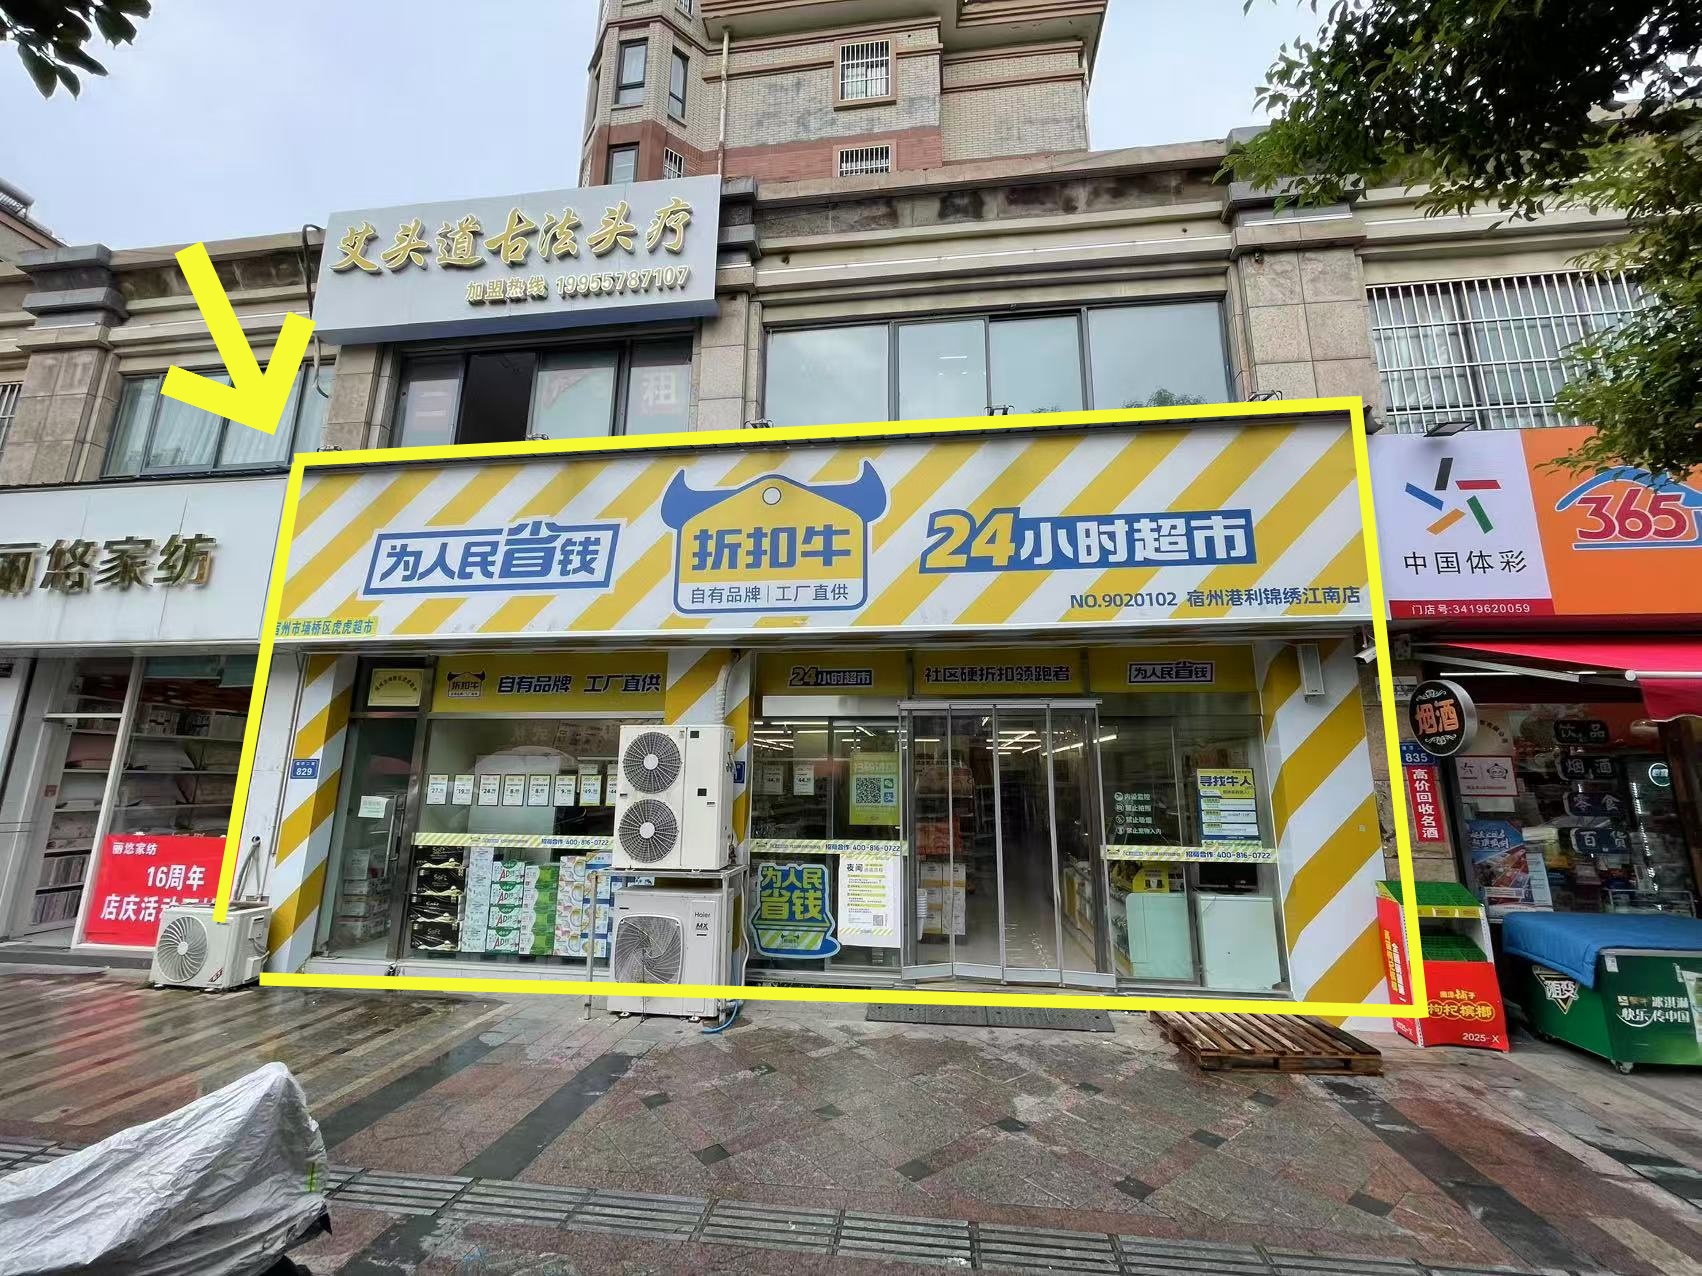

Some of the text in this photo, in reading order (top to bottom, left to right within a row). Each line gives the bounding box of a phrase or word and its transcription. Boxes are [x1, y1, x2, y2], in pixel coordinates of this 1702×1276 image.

[329, 196, 693, 273] 艾头道古法头疗
[466, 264, 691, 303] 加盟热线 19955787107
[1576, 487, 1689, 540] 365
[692, 524, 852, 571] 折扣牛
[925, 511, 1249, 568] 24小时超市
[379, 521, 601, 582] 为人民省钱
[1404, 550, 1527, 575] 中国体彩
[690, 583, 849, 604] 自有品牌 工厂直供
[1070, 587, 1361, 609] NO.9020102 宿州港利锦绣江南店
[790, 667, 871, 685] 24小时超市
[925, 666, 1071, 682] 社区硬折扣领跑者
[1134, 661, 1208, 680] 为人民省钱
[498, 673, 662, 693] 自有品牌 工厂直供
[1405, 753, 1428, 763] 835
[296, 767, 313, 776] 829
[1200, 775, 1252, 786] 寻找牛人
[1412, 768, 1439, 838] 高价回收名酒
[112, 842, 158, 855] 丽悠家纺
[1217, 851, 1271, 859] 400-816-0722
[147, 864, 206, 891] 16周年
[761, 867, 824, 888] 为人民
[760, 889, 823, 920] 省钱
[1428, 1003, 1493, 1018] 枸杞槟榔
[1462, 1032, 1500, 1043] 2025-X
